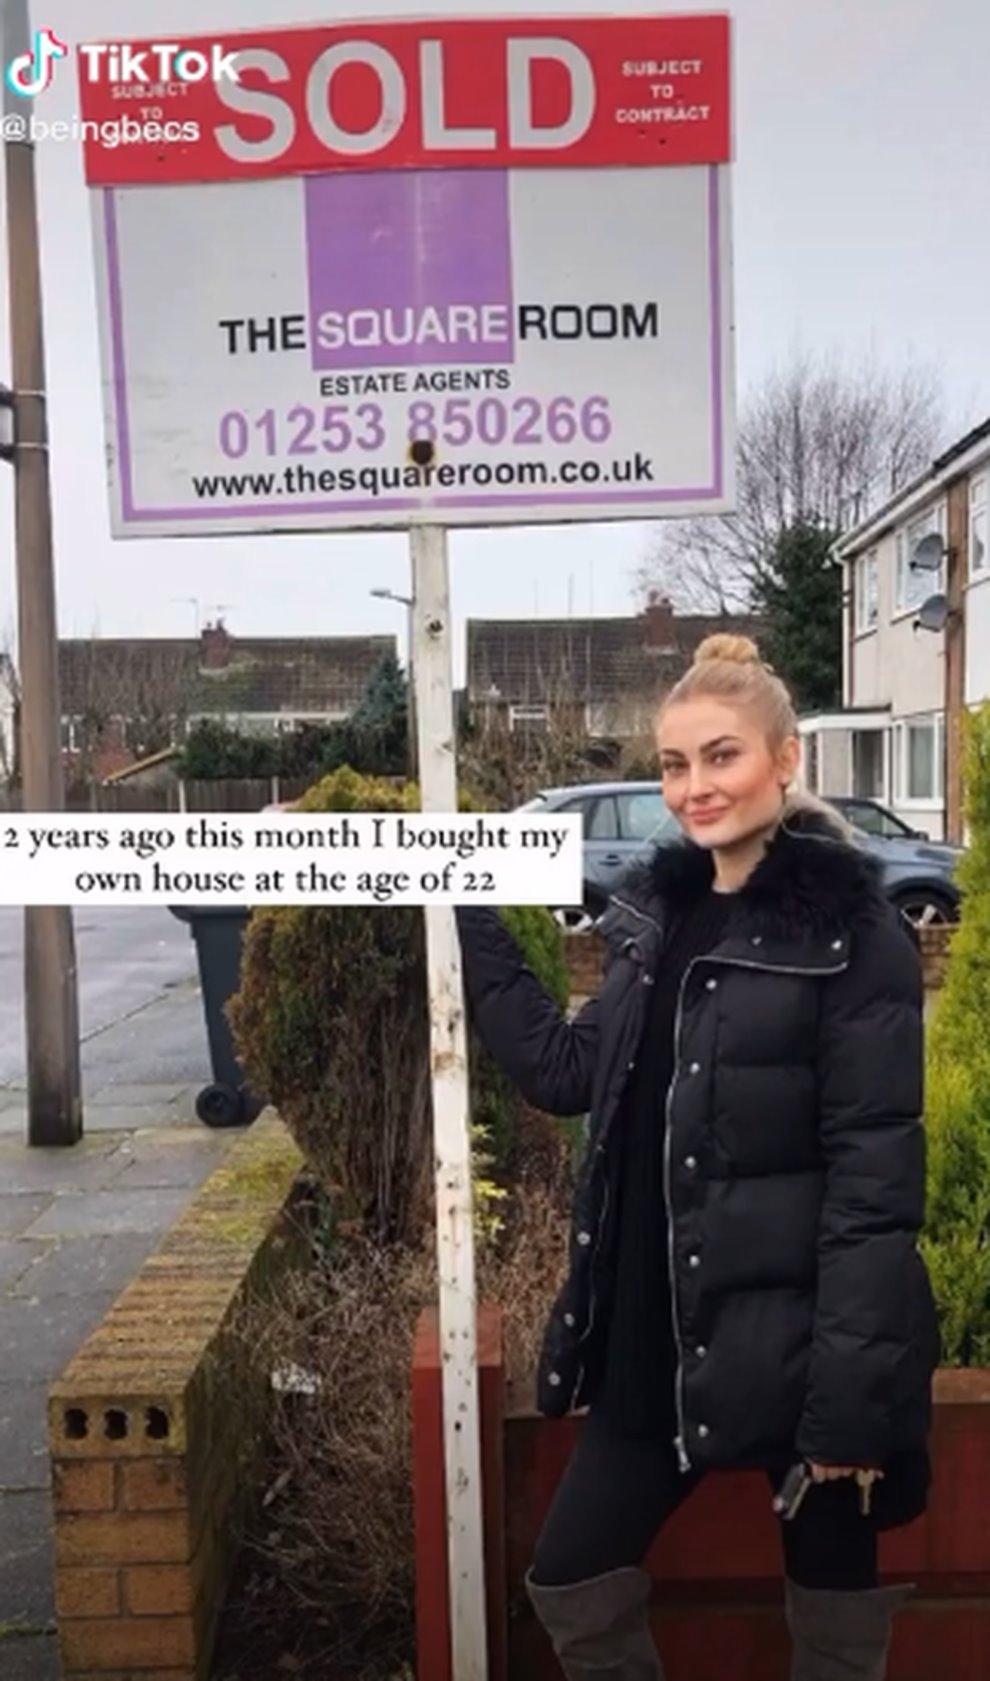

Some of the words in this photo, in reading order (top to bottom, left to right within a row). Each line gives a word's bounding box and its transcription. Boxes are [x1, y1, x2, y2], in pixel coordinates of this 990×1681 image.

[622, 59, 702, 77] SUBJECT
[111, 82, 189, 99] SUBJECT
[213, 38, 596, 163] SOLD
[650, 84, 674, 99] TO
[140, 106, 163, 120] TO
[615, 105, 710, 123] CONTRACT
[219, 315, 307, 354] THE
[317, 305, 509, 349] SQUARE
[518, 302, 658, 340] ROOM
[320, 372, 407, 397] ESTATE
[413, 369, 510, 392] AGENTS
[219, 403, 385, 459] 01253
[408, 396, 611, 447] 850266
[193, 452, 654, 497] www.thesquareroom.co.uk
